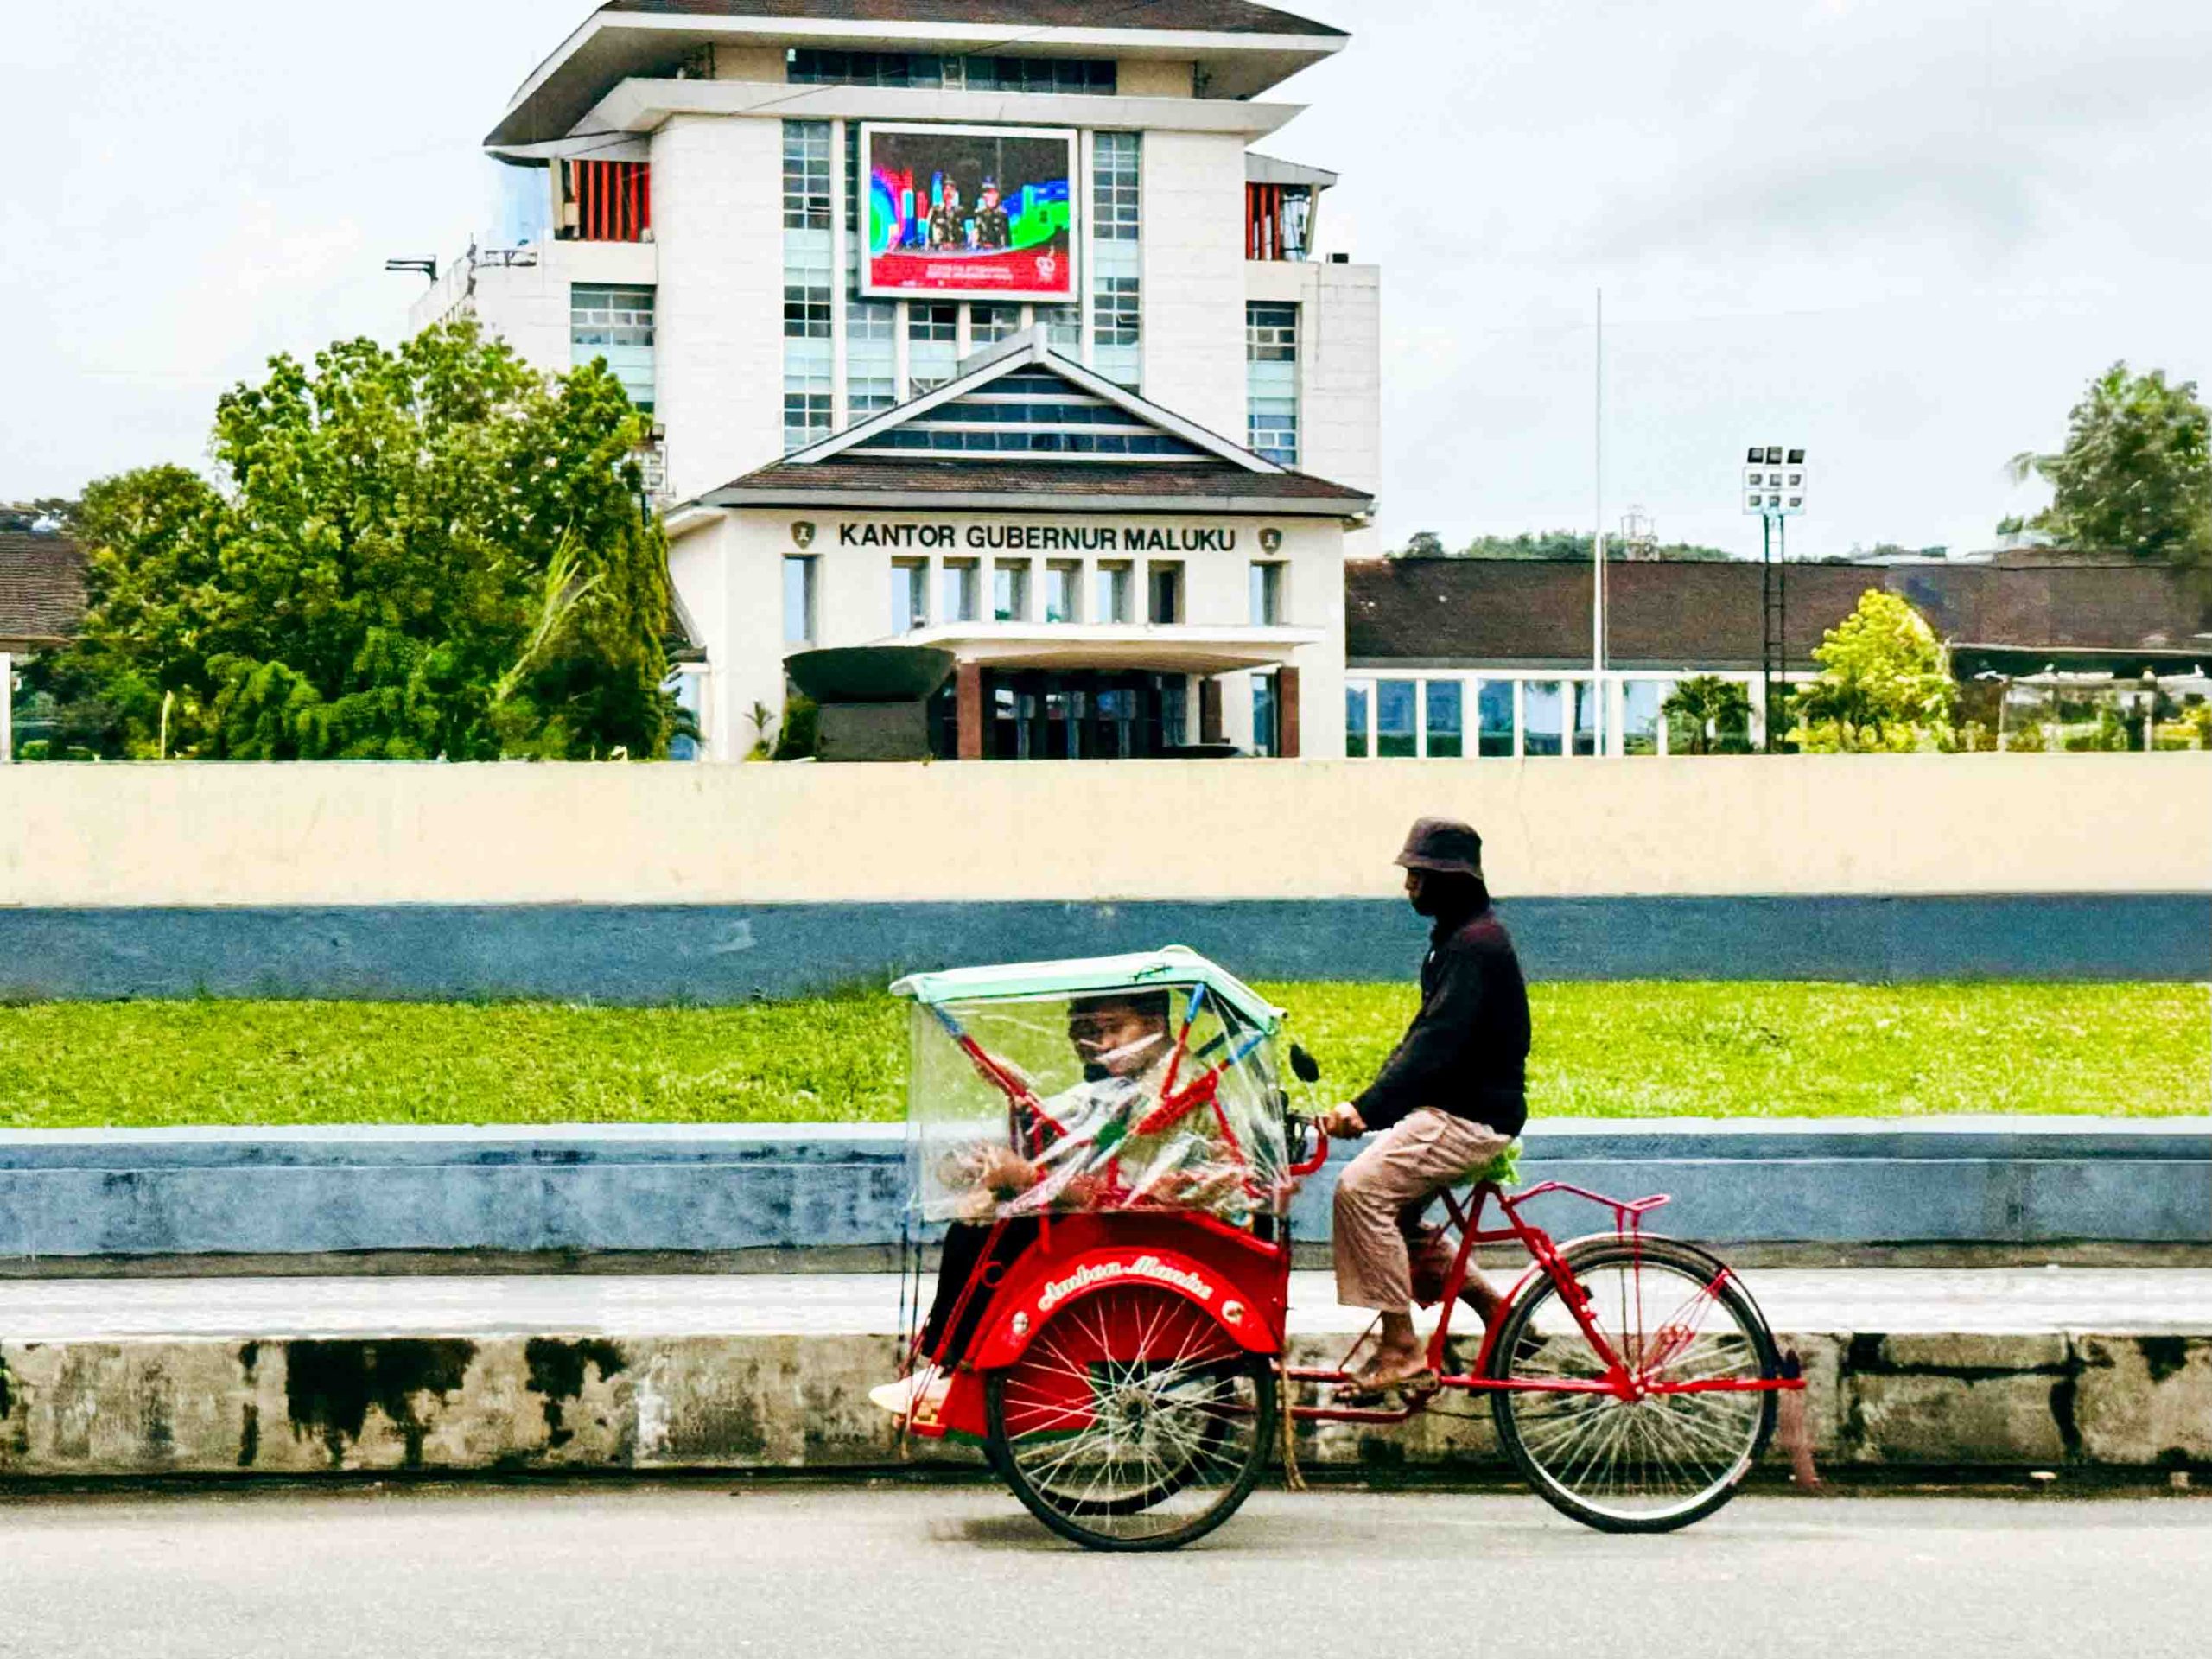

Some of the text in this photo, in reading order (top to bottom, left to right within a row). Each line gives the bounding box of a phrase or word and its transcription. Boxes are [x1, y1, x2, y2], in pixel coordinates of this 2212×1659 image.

[839, 523, 1236, 551] KANTOR GUBERNUR MALUKU
